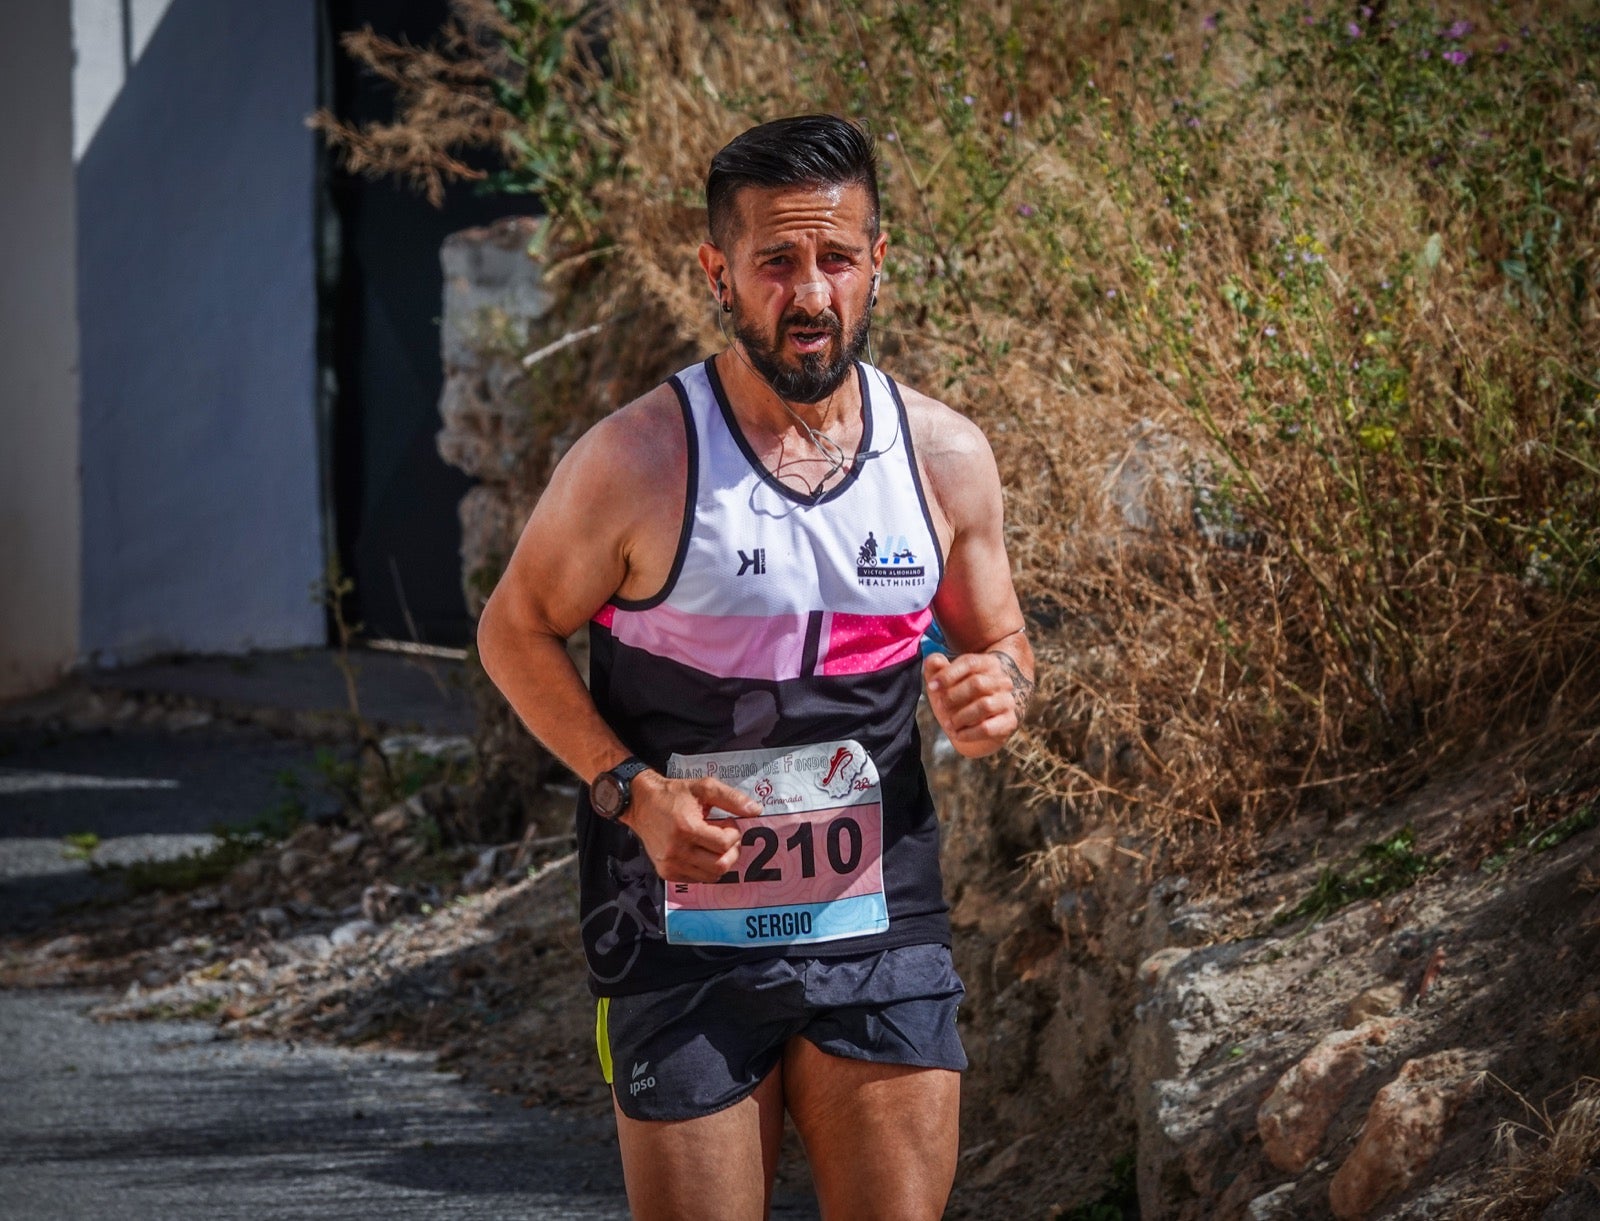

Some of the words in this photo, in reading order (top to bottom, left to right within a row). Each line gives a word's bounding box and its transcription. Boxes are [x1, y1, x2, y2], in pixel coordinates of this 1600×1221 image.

[858, 578, 925, 587] HEALTHINESS
[706, 761, 758, 779] PREMIO
[783, 754, 829, 773] FONDO
[765, 794, 803, 806] Granada
[703, 817, 863, 884] 210
[745, 911, 812, 939] SERGIO
